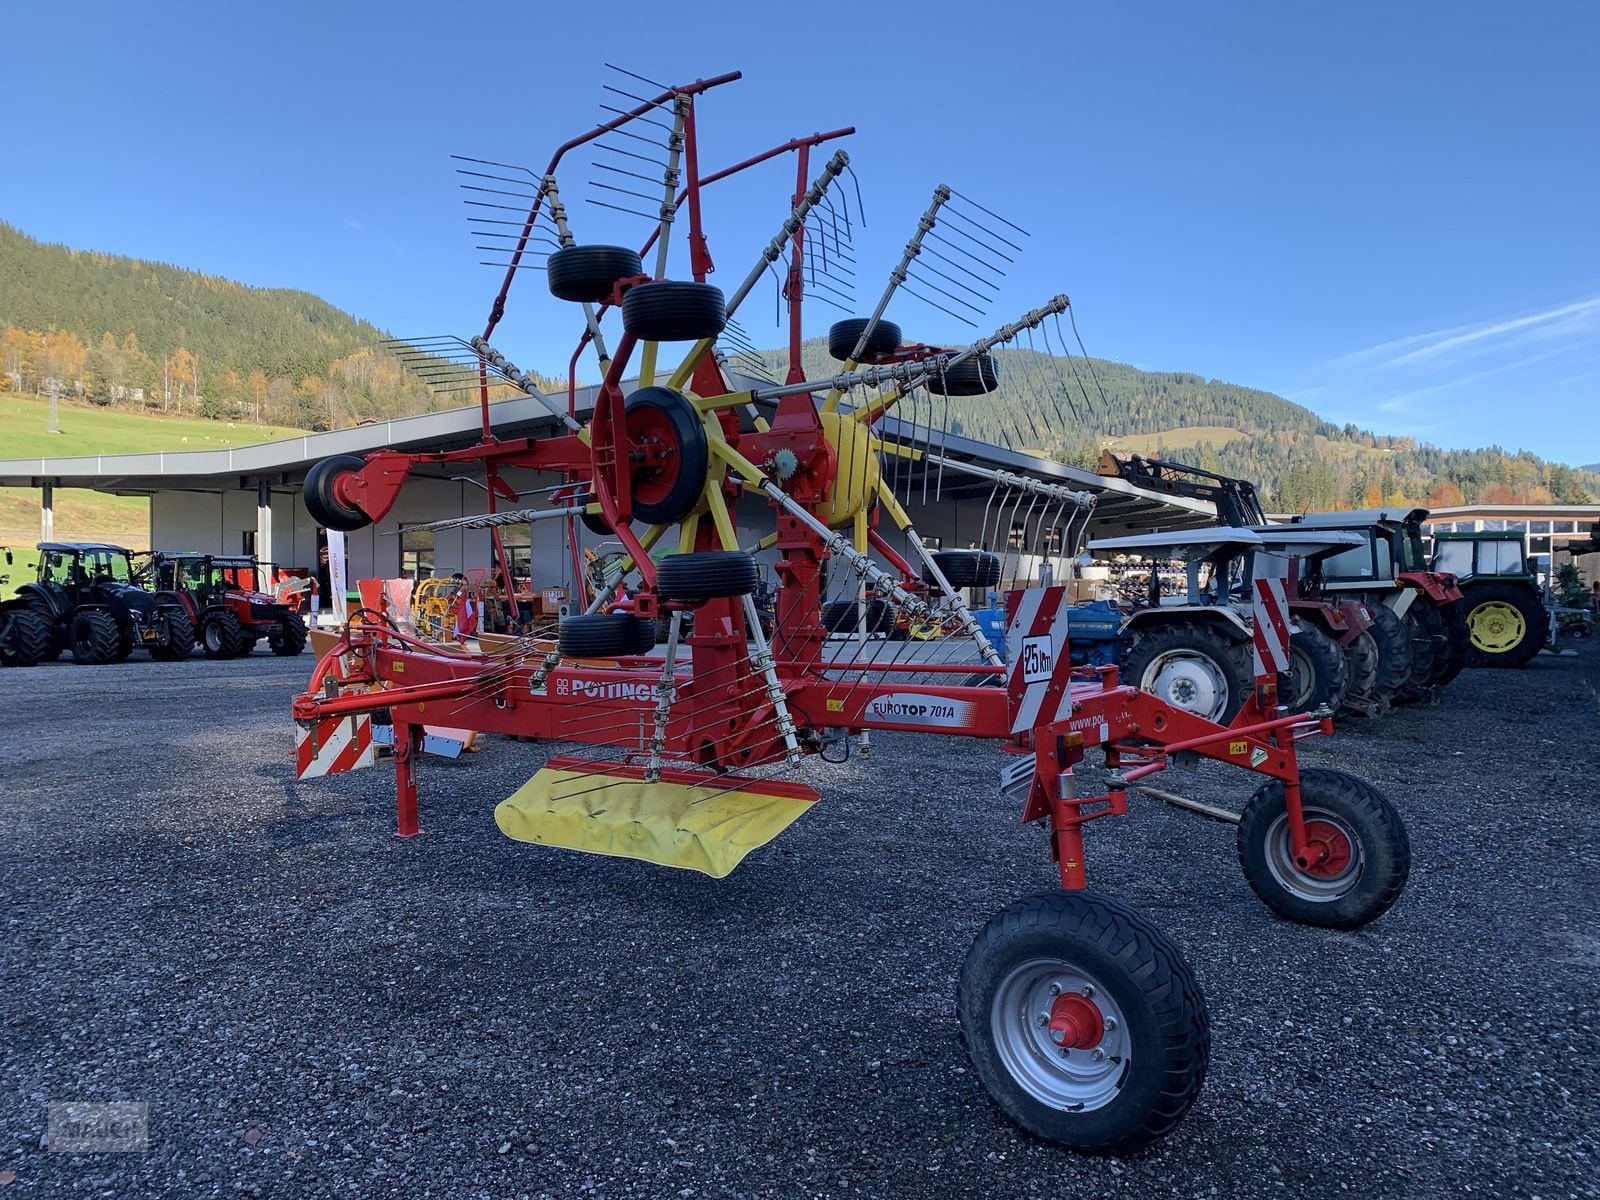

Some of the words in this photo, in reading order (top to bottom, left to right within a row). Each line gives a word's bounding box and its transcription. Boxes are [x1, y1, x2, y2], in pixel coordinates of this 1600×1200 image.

[1025, 644, 1039, 675] 25
[1039, 649, 1052, 673] km
[873, 702, 927, 716] EUROTOP
[929, 705, 955, 718] 701A
